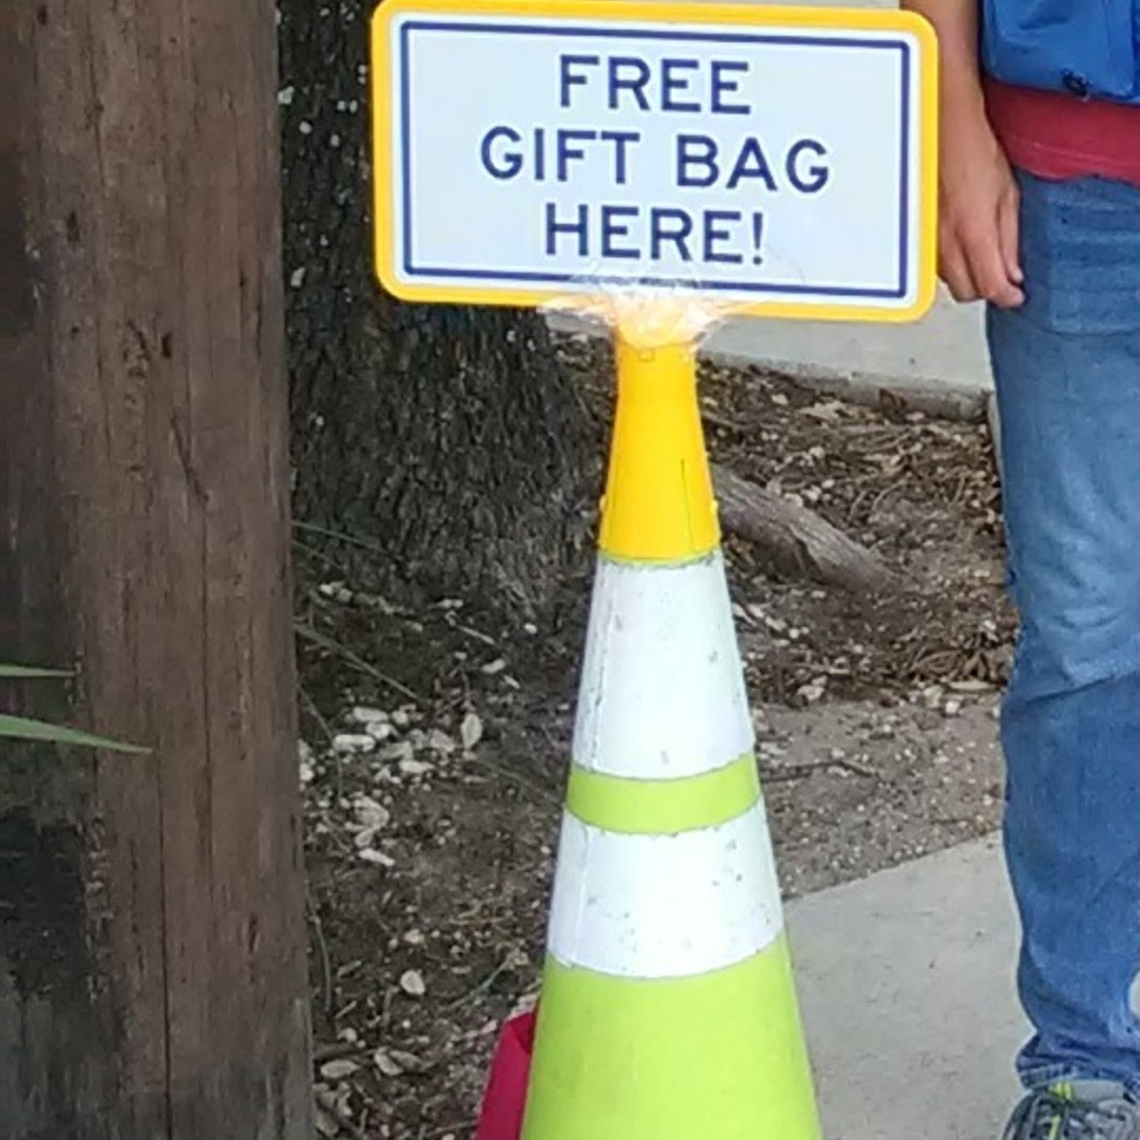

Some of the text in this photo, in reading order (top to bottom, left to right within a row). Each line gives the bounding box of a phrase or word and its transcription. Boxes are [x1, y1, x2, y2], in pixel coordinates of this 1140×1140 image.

[559, 54, 751, 115] FREE
[480, 126, 829, 193] GIFT BAG
[546, 202, 763, 265] HERE!
